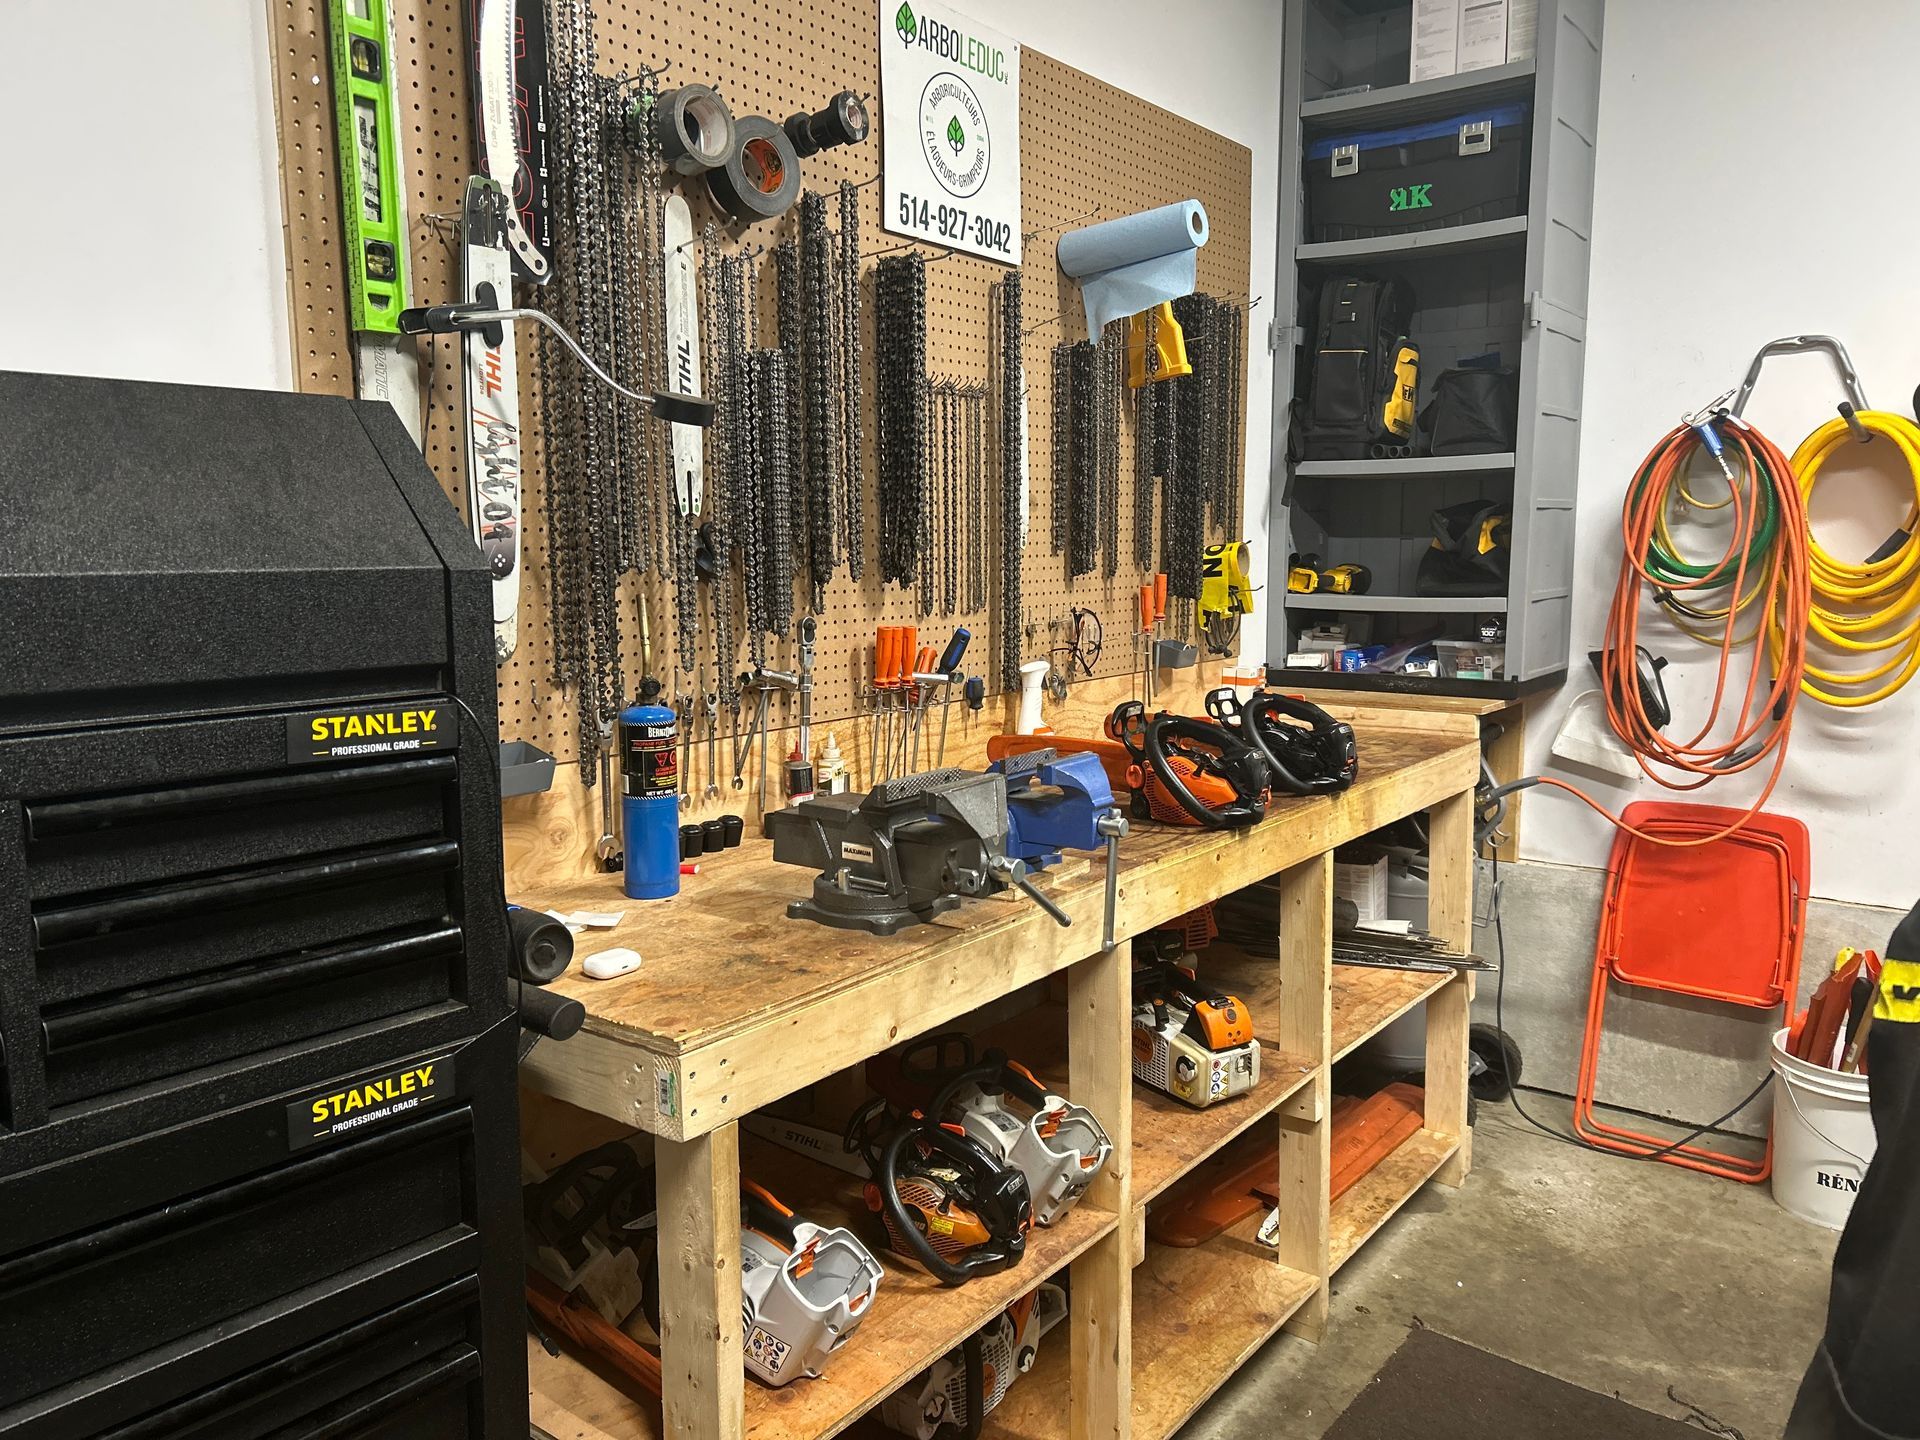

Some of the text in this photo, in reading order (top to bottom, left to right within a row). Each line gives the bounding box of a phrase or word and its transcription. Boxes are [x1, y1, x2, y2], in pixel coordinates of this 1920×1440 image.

[929, 83, 981, 127] ARBORICULTEURS
[900, 192, 1011, 254] 514-927-3042
[485, 346, 502, 399] IHL
[678, 340, 692, 395] TIHL
[311, 710, 437, 741] STANLEY
[331, 740, 420, 757] PROFESSIONAL GRADE
[843, 846, 872, 857] MAXIMUM
[312, 1065, 434, 1123] STANLEY
[331, 1097, 419, 1134] PROFESSIONAL GRADE
[784, 1130, 822, 1150] STIHL
[1816, 1171, 1861, 1193] RÉN
